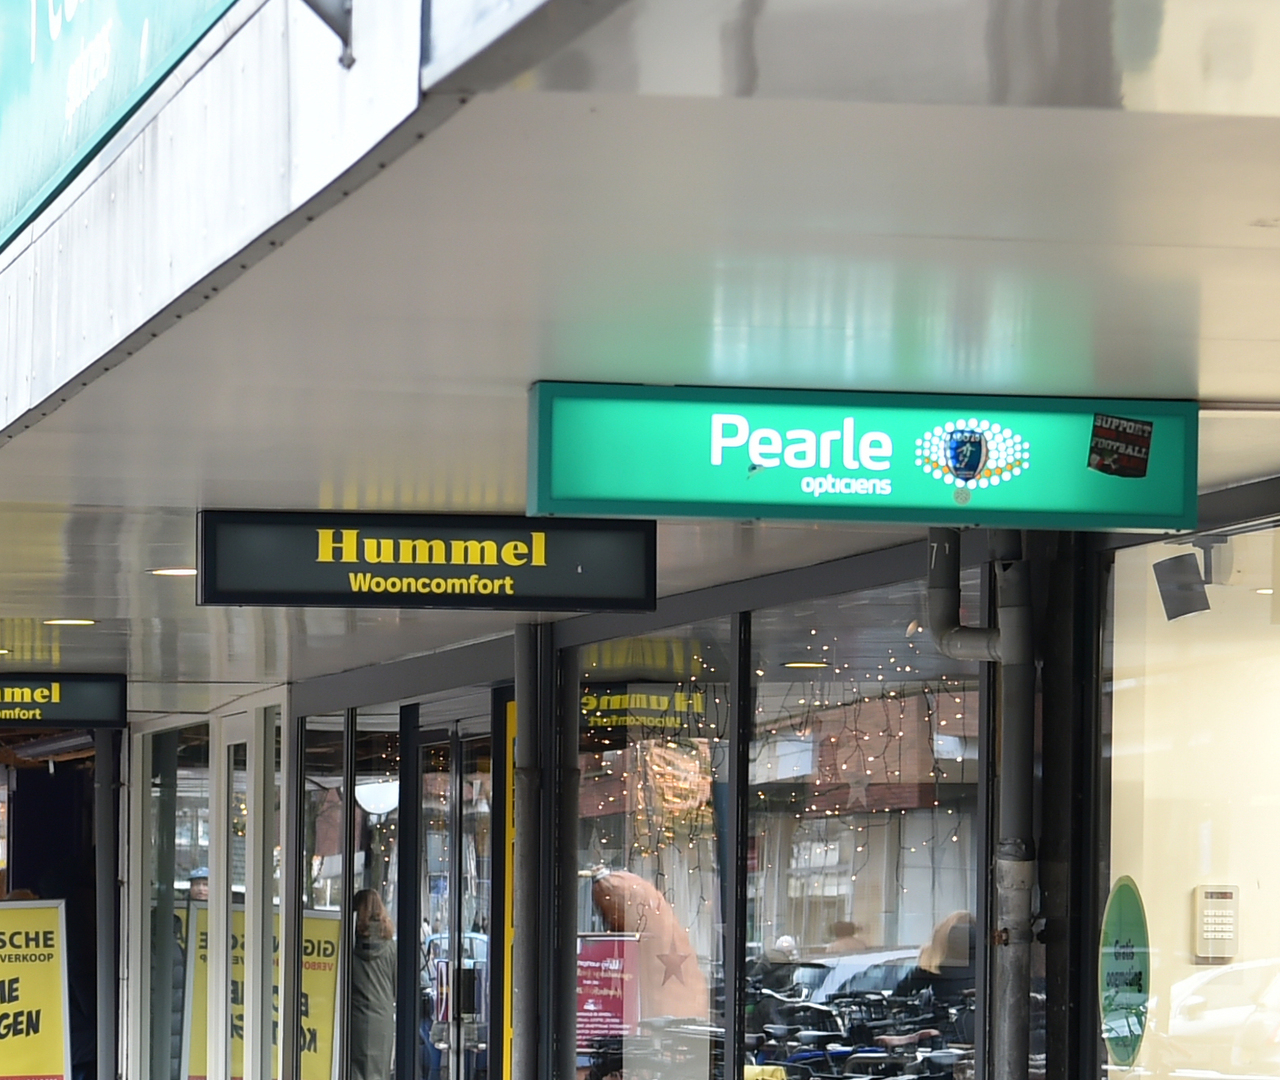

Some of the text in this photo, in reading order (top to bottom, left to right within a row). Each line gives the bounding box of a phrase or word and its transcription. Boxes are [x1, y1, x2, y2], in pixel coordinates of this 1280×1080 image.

[1095, 415, 1151, 437] SUPPORT
[710, 413, 892, 471] Pearle
[1092, 437, 1147, 458] FOOTBALL
[801, 473, 892, 496] opticiens
[315, 529, 547, 566] Hummel
[349, 572, 514, 595] Wooncomfort
